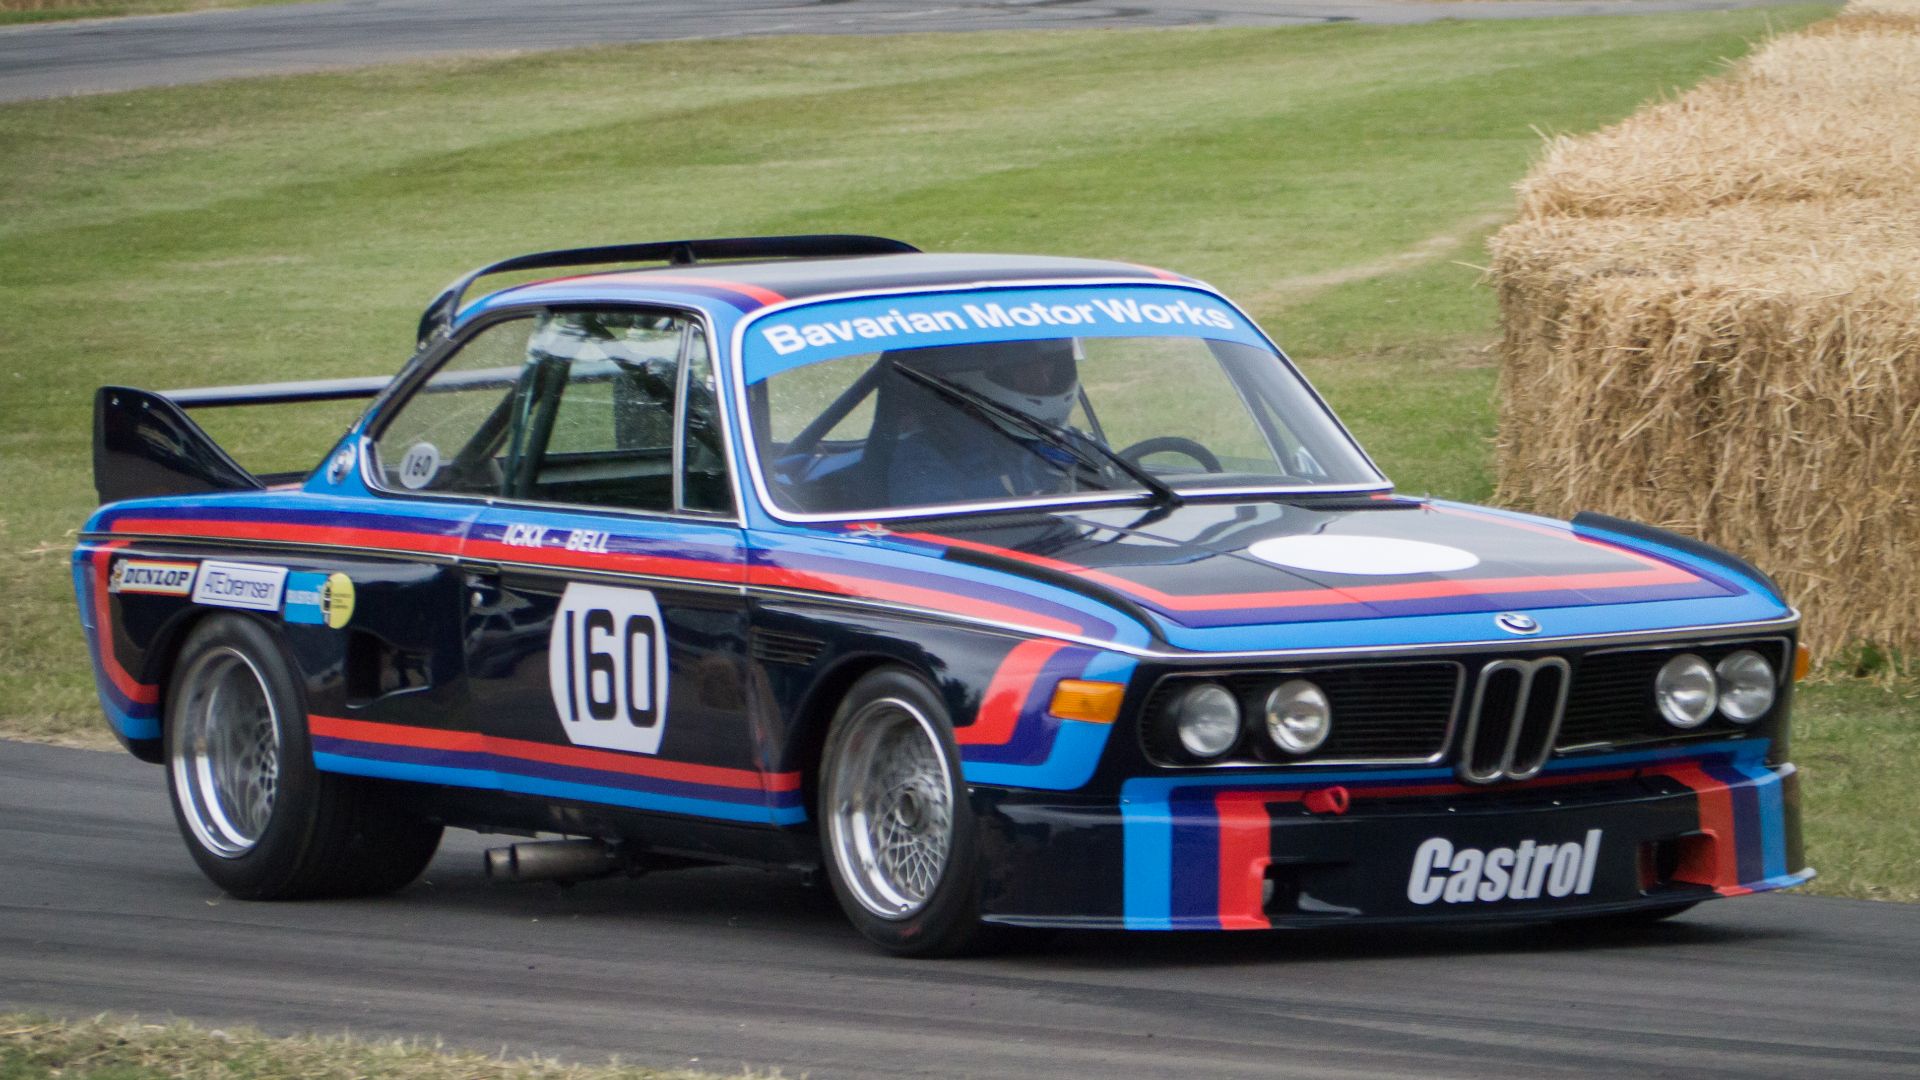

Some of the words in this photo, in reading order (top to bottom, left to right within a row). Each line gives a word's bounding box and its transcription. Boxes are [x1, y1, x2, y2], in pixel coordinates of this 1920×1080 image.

[761, 308, 968, 355] Bavarian
[963, 302, 1096, 329] Motor
[1091, 298, 1234, 330] Works
[405, 454, 432, 477] 160
[502, 524, 548, 548] ICKX
[566, 530, 609, 553] BELL
[123, 566, 190, 587] DUNLOP
[565, 608, 657, 728] 160
[1407, 829, 1603, 905] Castrol
